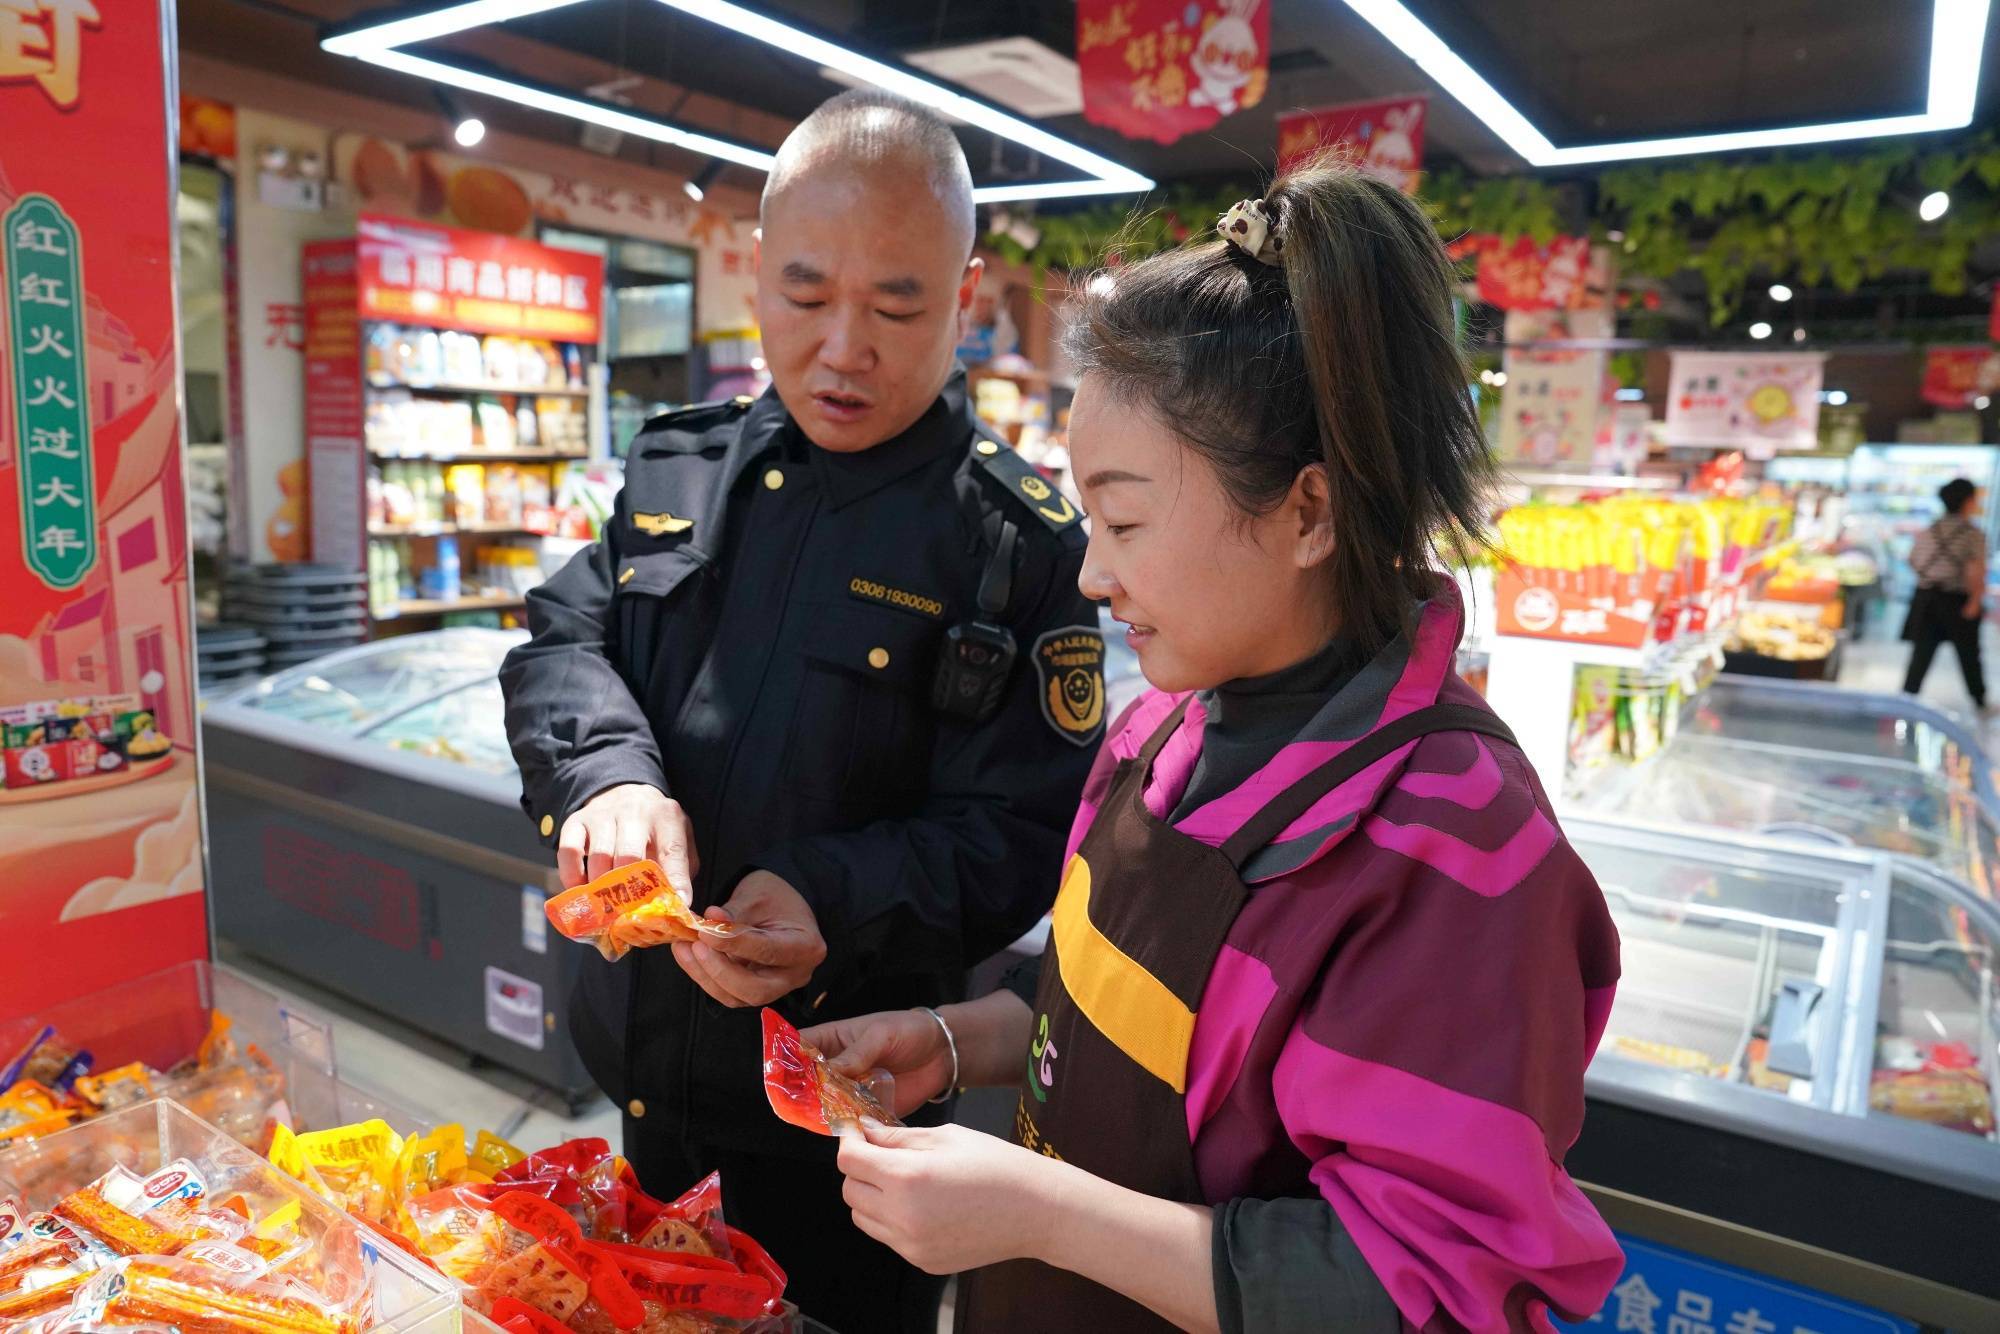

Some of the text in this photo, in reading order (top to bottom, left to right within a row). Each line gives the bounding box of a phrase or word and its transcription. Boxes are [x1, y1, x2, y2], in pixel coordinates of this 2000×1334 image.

[15, 219, 87, 559] 红红火火过大年
[850, 578, 943, 615] 03061930090
